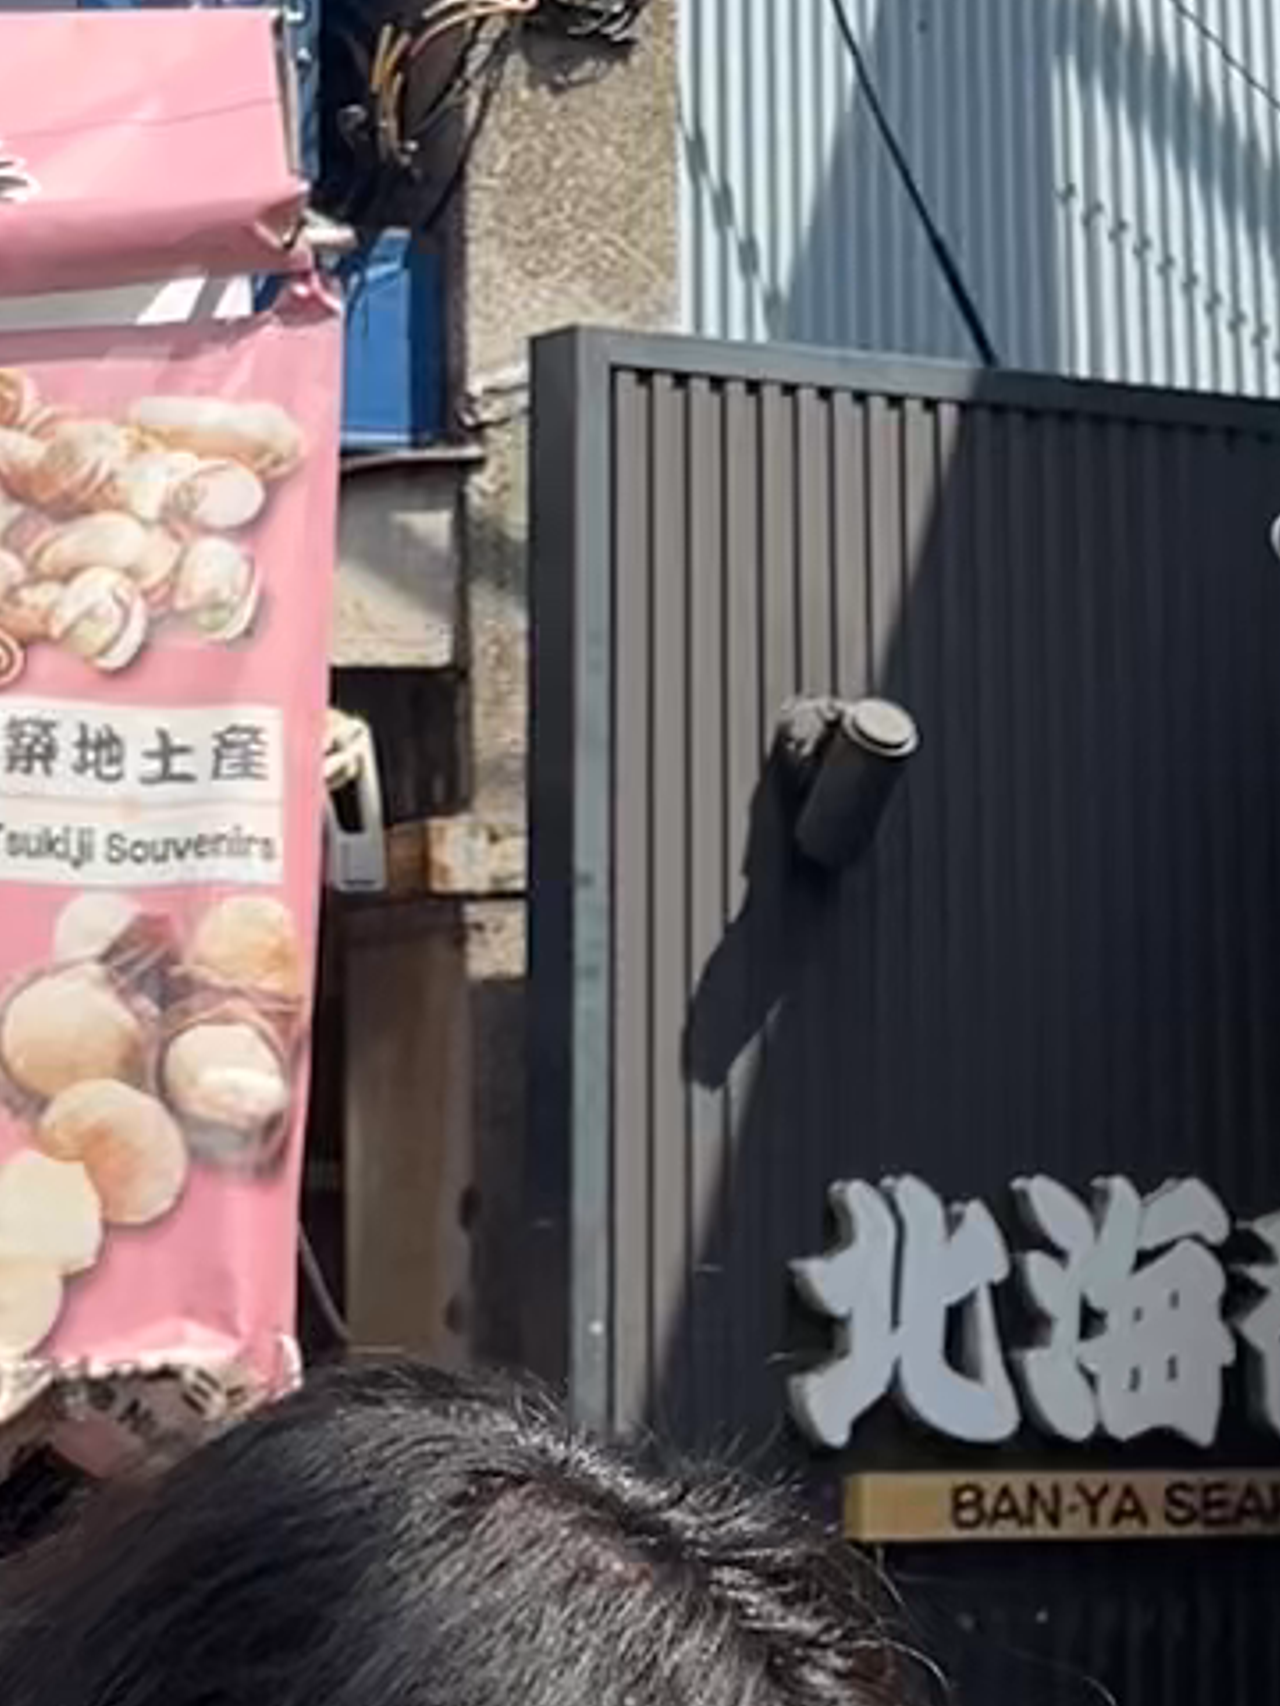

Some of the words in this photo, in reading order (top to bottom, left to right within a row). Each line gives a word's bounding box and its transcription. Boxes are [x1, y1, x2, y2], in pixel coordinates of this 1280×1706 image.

[4, 718, 270, 785] 築地土産
[105, 823, 278, 866] Souvenirs
[950, 1483, 1148, 1529] BAN-YA
